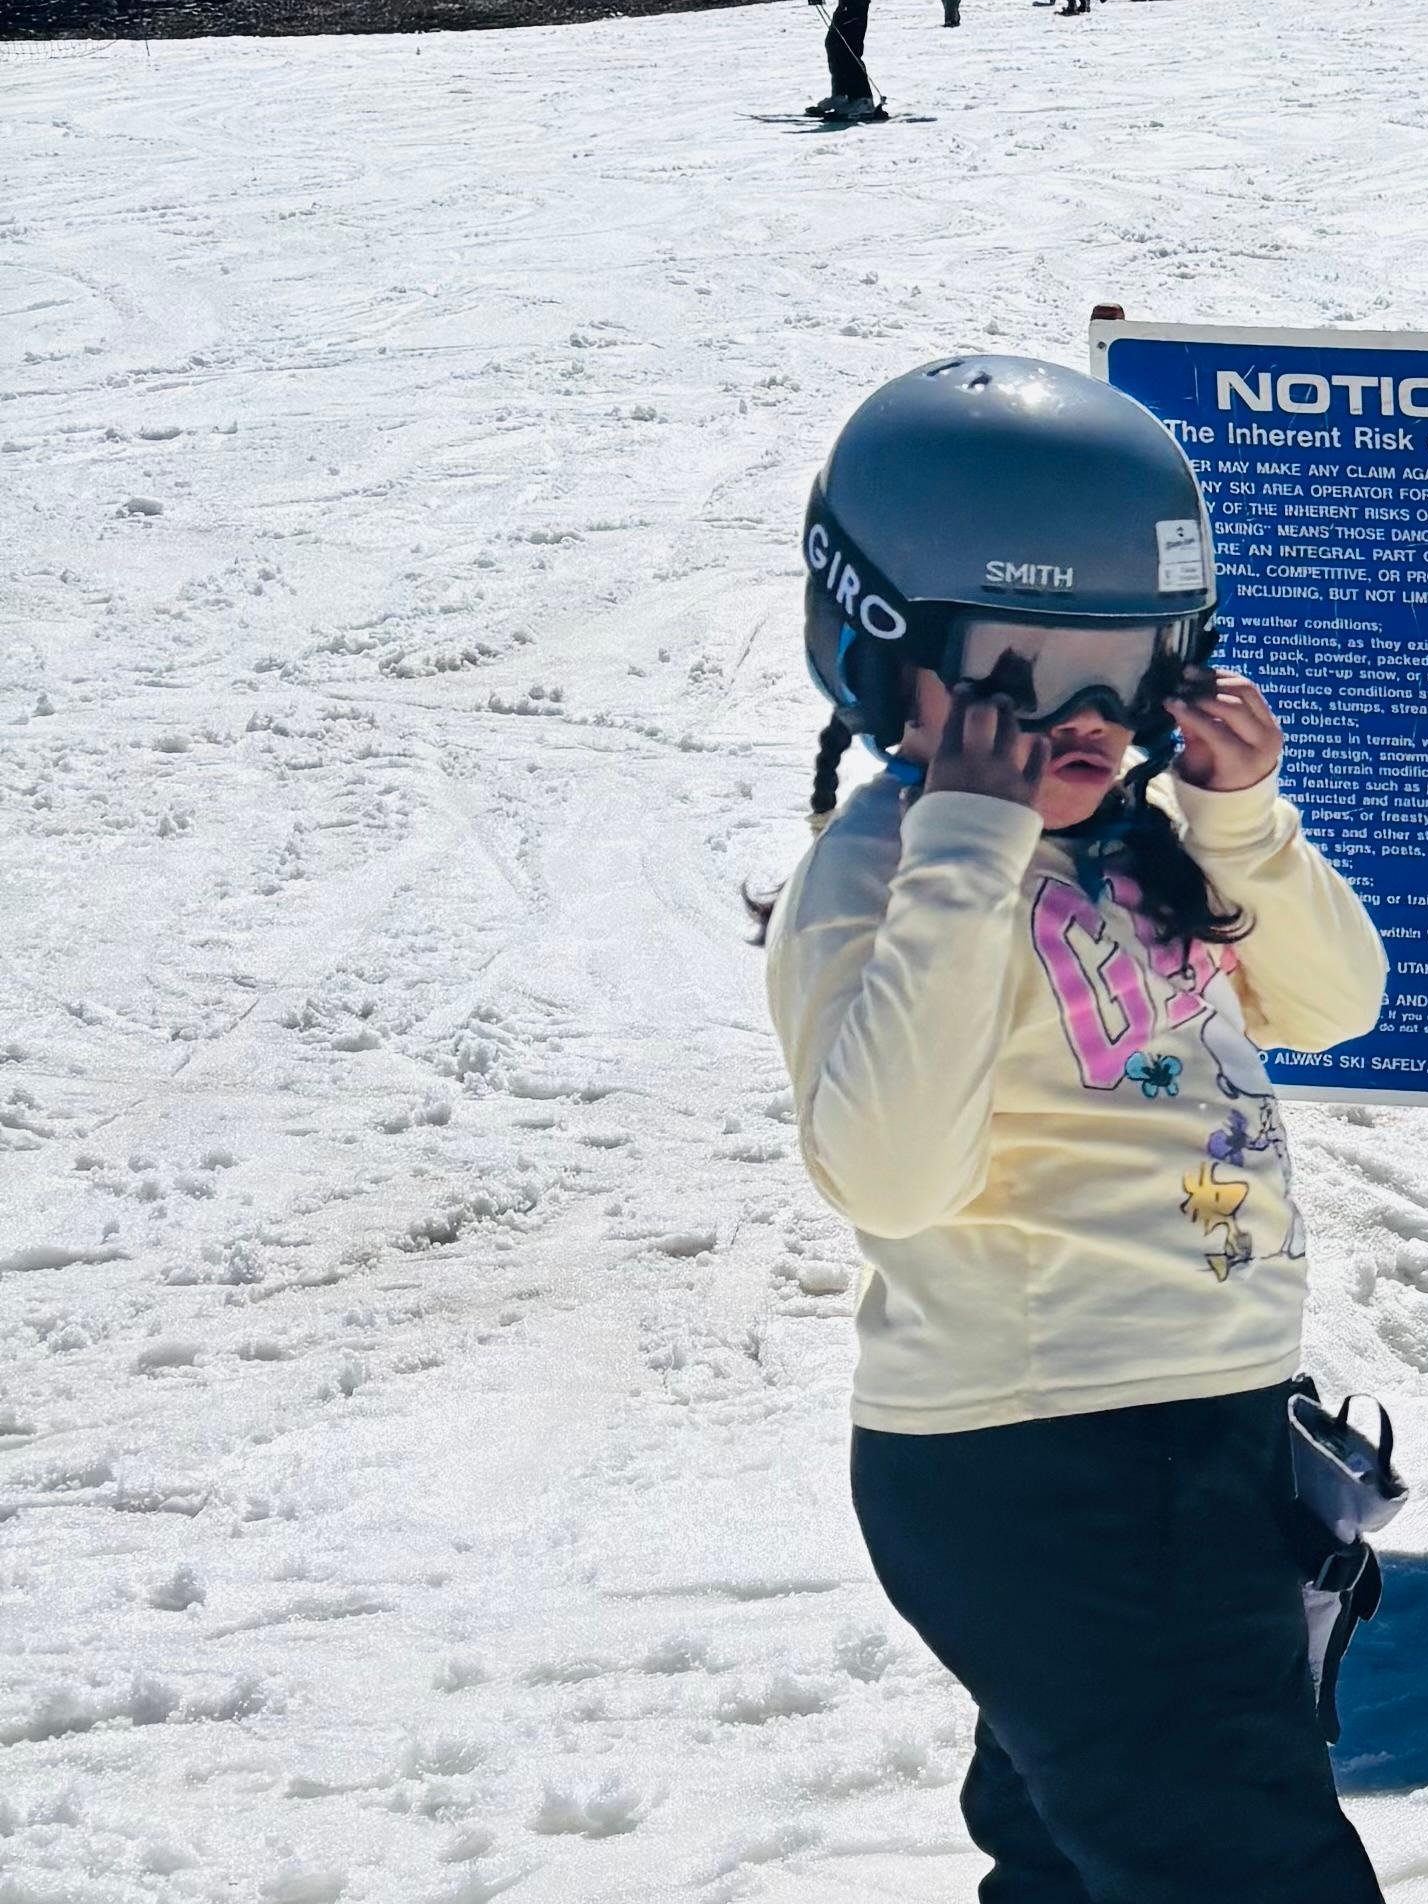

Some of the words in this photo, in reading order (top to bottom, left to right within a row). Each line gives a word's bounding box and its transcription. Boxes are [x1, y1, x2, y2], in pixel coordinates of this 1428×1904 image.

[1164, 419, 1215, 444] The
[1228, 422, 1342, 448] Inherent
[1354, 426, 1414, 451] Risk
[1218, 460, 1249, 474] MAY
[1256, 462, 1301, 476] MAKE
[1308, 464, 1339, 477] ANY
[1346, 465, 1396, 479] CLAIM
[1201, 481, 1222, 493] NY
[1229, 481, 1255, 495] SKI
[1262, 483, 1304, 497] AREA
[1310, 484, 1393, 499] OPERATOR
[1222, 501, 1242, 515] OF
[1248, 502, 1278, 516] THE
[1284, 504, 1359, 519] INHERENT
[1364, 507, 1410, 521] RISKS
[1277, 524, 1330, 539] MEANS
[1337, 526, 1385, 541] THOSE
[1213, 542, 1241, 556] RE
[1248, 544, 1272, 557] AN
[1280, 545, 1365, 560] INTEGRAL
[1373, 548, 1416, 562] PART
[807, 523, 907, 640] GIRO
[986, 561, 1073, 587] SMITH
[1378, 569, 1400, 582] OR
[1329, 587, 1359, 601] BUT
[1365, 589, 1396, 602] NOT
[1274, 1052, 1333, 1067] ALWAYS
[1339, 1055, 1365, 1069] SKI
